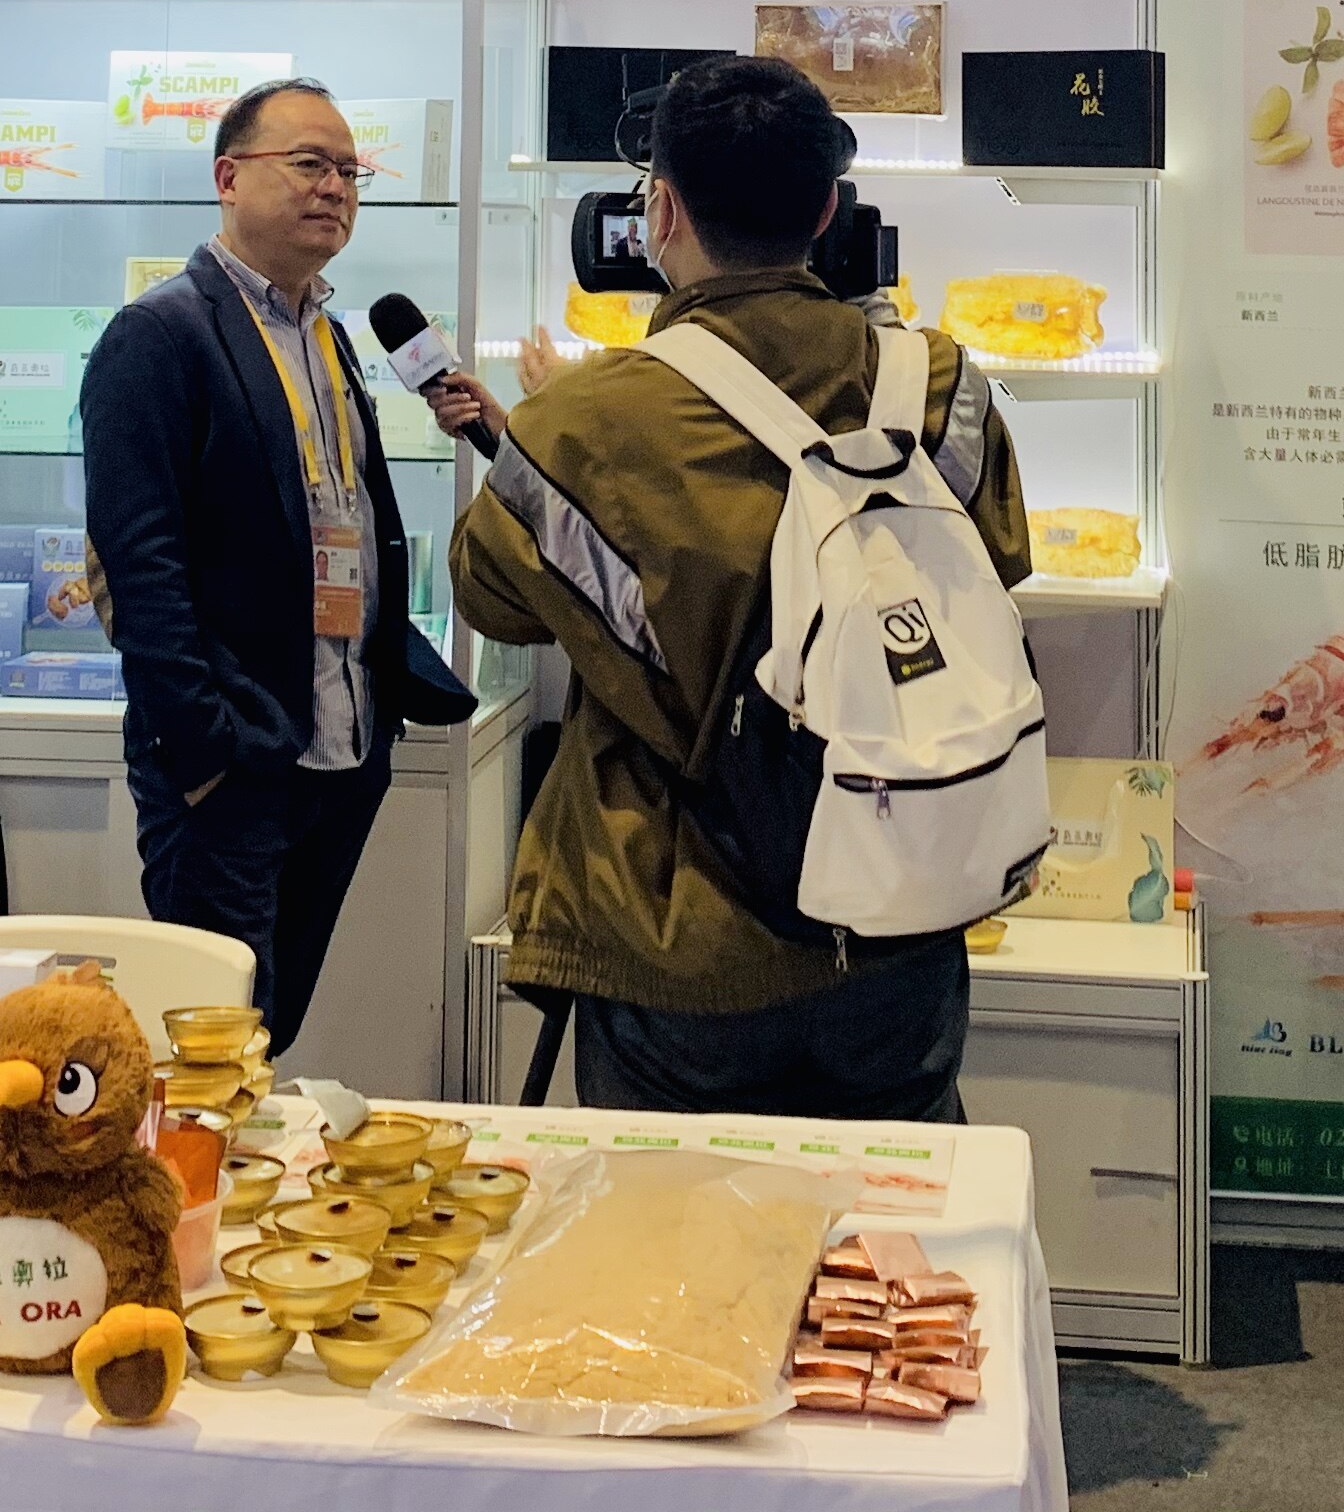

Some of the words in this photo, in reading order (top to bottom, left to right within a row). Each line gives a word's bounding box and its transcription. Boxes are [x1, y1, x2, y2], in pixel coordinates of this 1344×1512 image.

[157, 75, 240, 95] SCAMPI
[354, 124, 391, 144] AMPI
[1240, 309, 1280, 323] 新西兰
[20, 1299, 83, 1323] ORA
